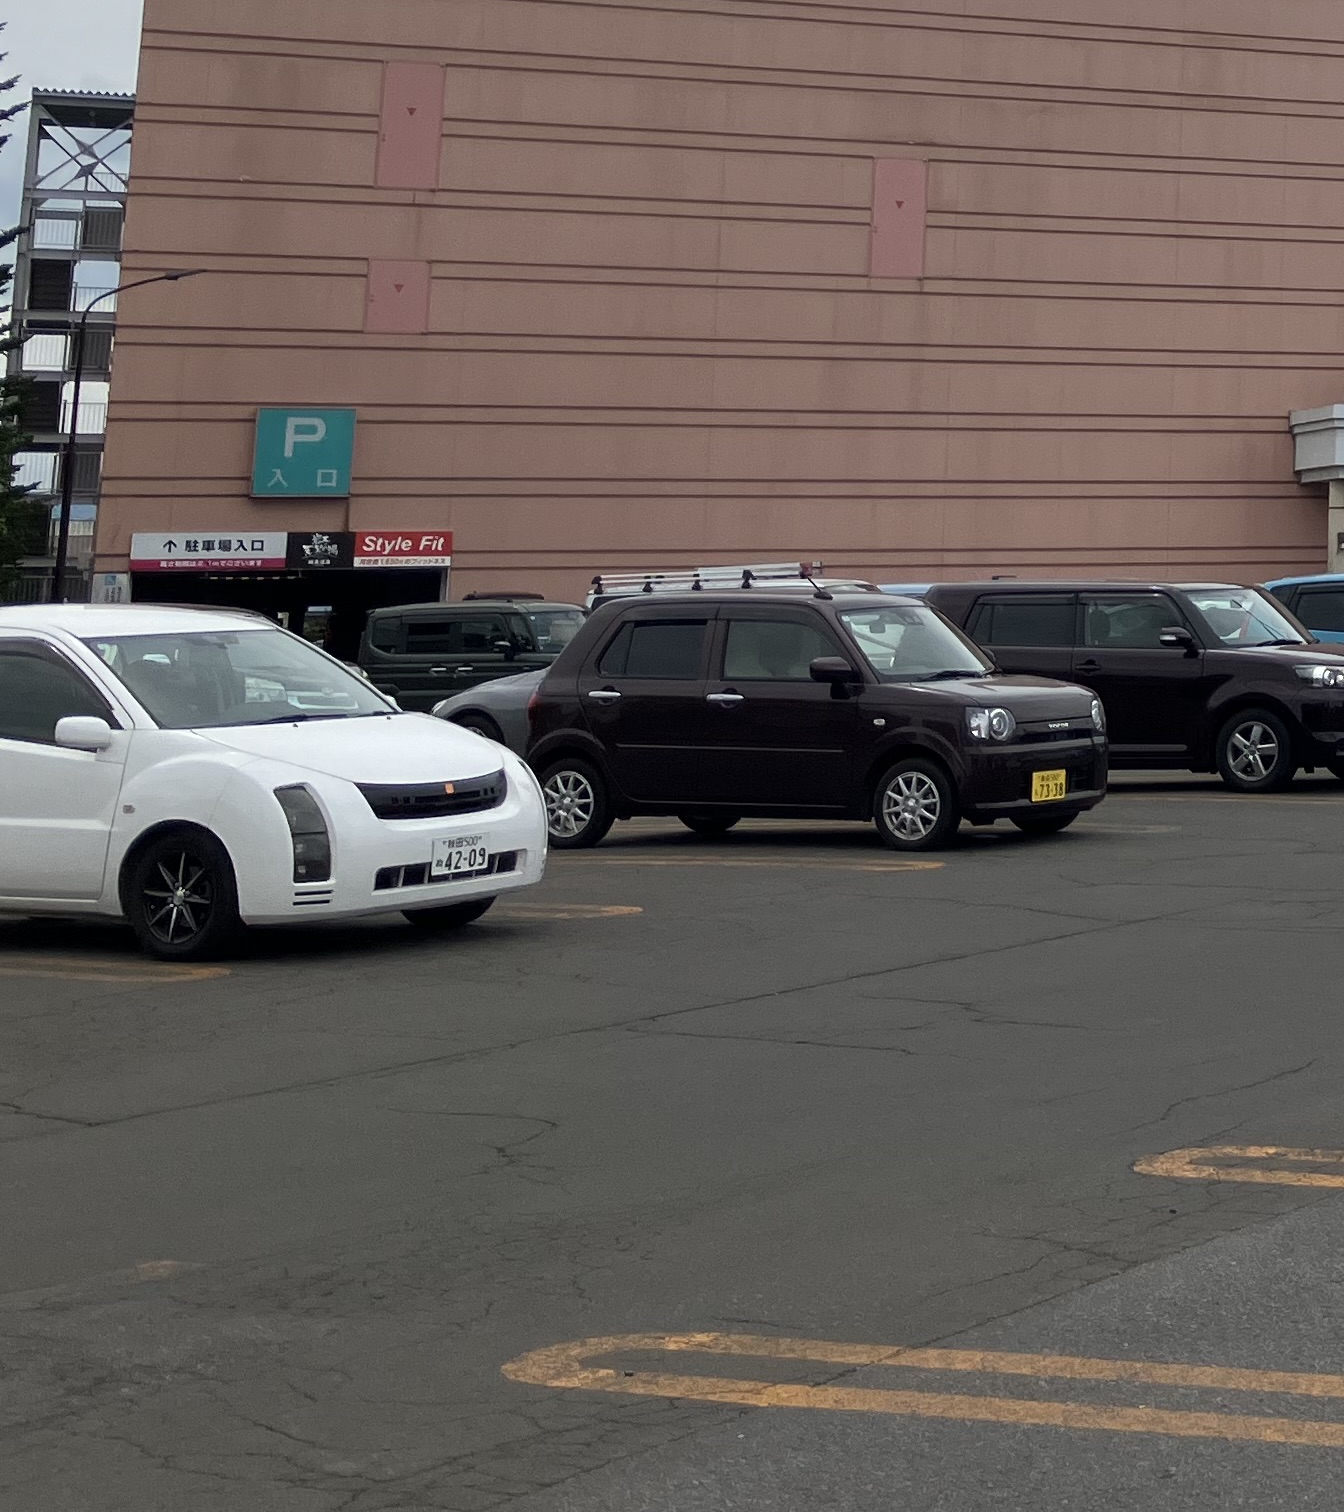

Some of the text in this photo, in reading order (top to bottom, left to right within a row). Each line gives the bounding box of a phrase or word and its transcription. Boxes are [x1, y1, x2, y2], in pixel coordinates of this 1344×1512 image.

[284, 417, 326, 457] P
[185, 539, 264, 552] 駐車場入口
[362, 536, 445, 555] Style Fit
[445, 848, 486, 871] 42-09
